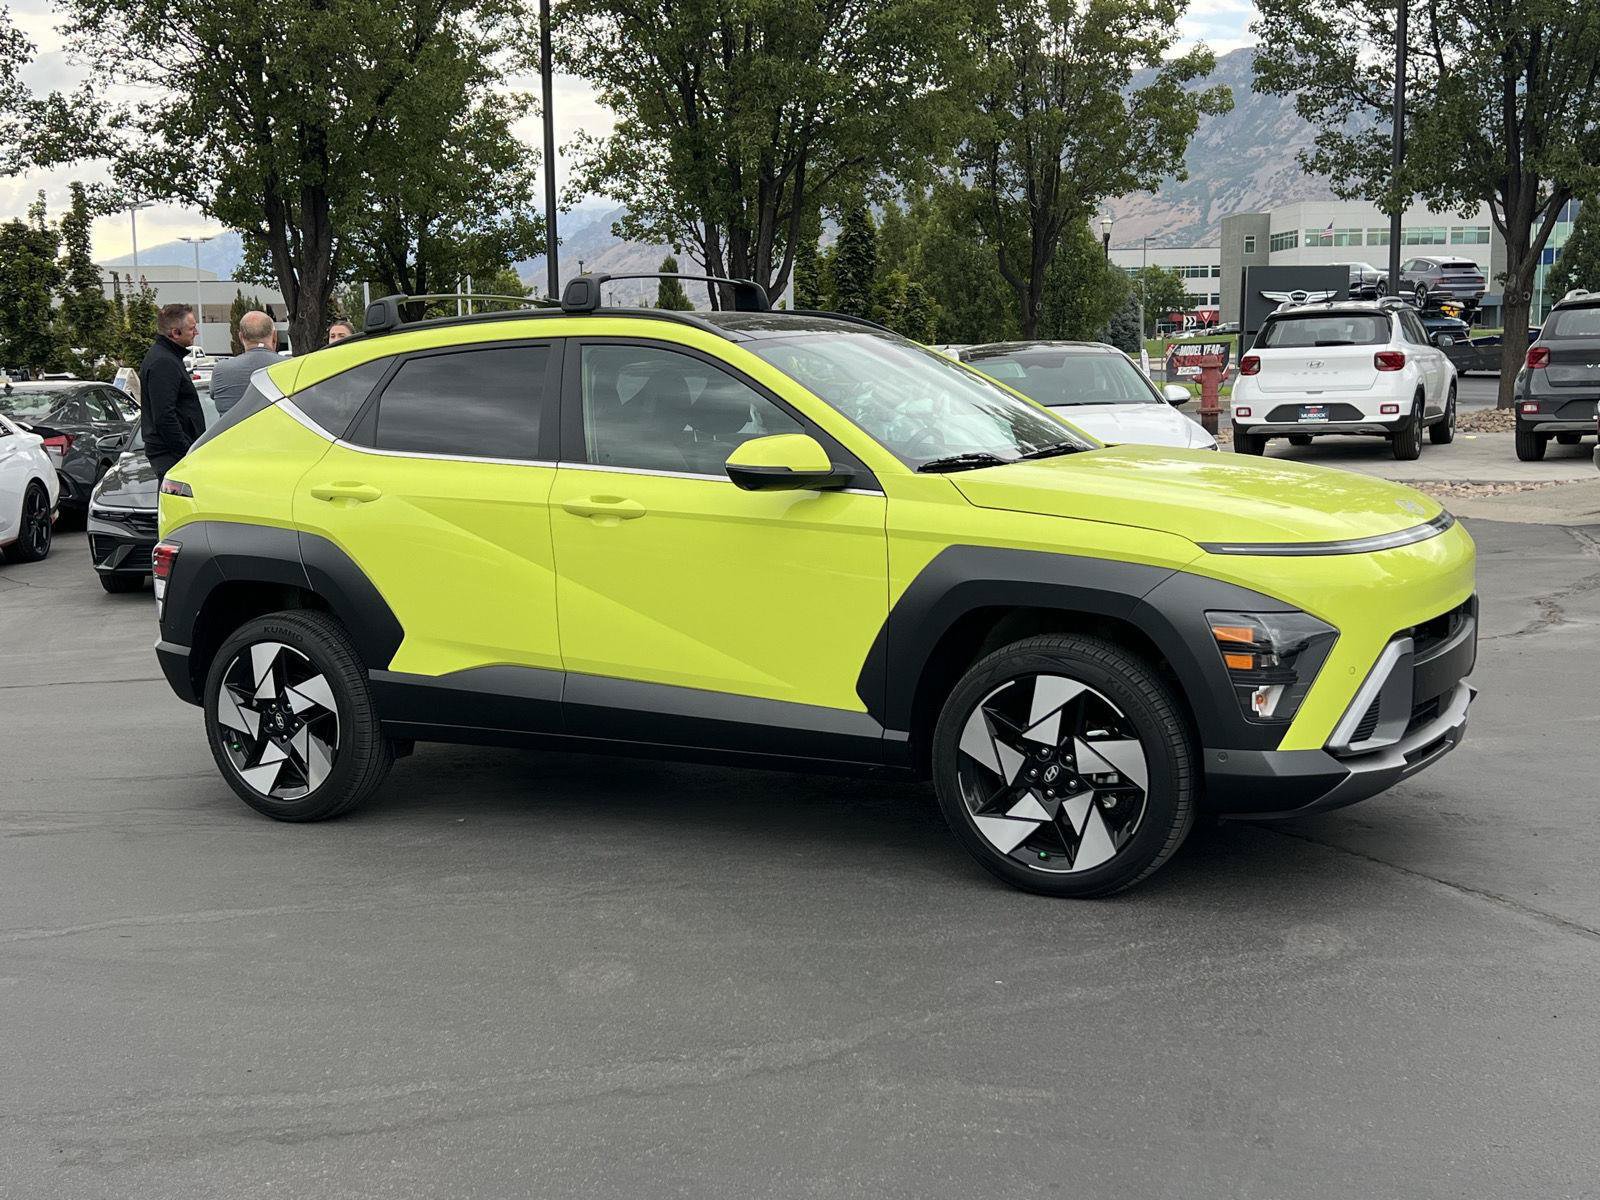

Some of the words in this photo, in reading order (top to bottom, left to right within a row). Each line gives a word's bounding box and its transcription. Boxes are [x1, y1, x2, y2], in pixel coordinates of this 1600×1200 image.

[1179, 345, 1202, 356] MODEL
[1203, 344, 1221, 355] YEAR
[263, 625, 304, 641] KUMHO
